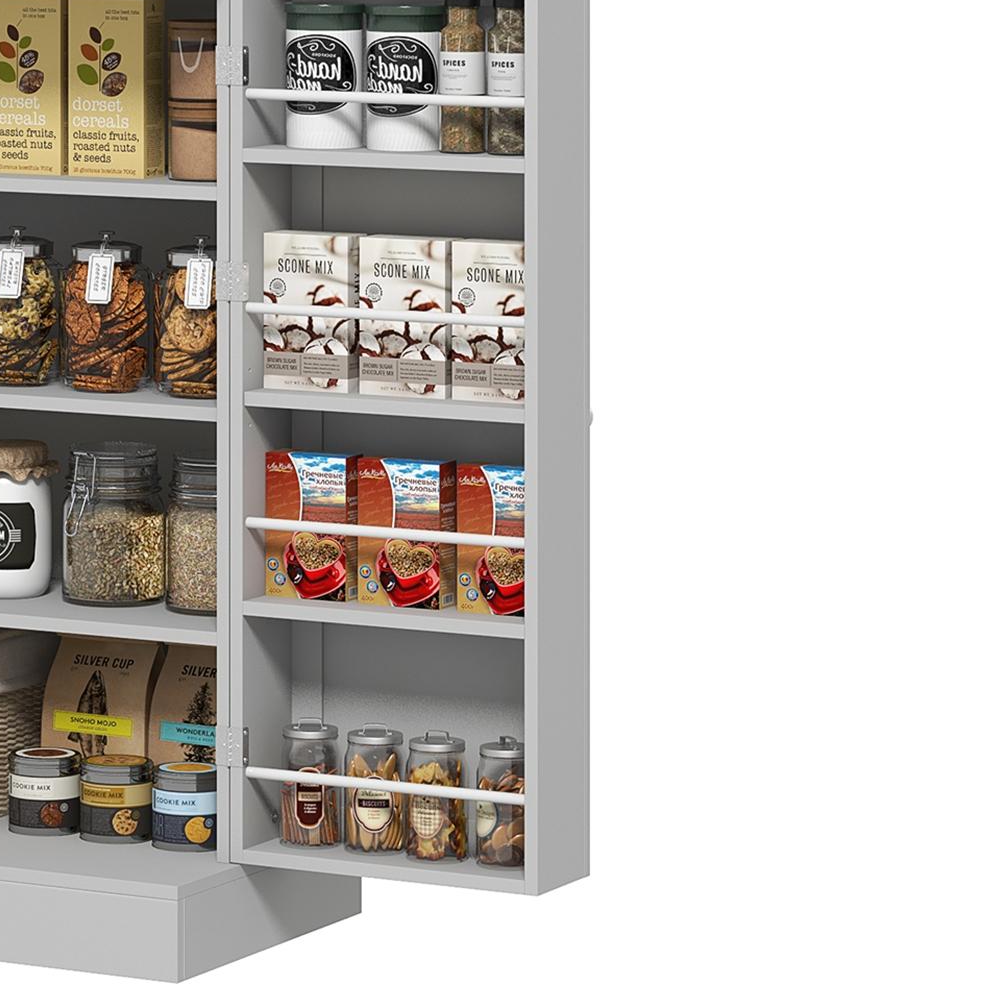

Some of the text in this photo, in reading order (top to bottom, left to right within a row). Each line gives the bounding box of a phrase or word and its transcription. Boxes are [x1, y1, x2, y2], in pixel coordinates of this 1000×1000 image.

[442, 59, 466, 67] SPICES
[491, 60, 515, 68] SPICES
[72, 97, 123, 113] dorset
[72, 114, 129, 129] cereals
[26, 128, 57, 140] fruits,
[72, 130, 140, 143] classic fruits,
[30, 141, 53, 150] nuts
[73, 142, 136, 153] roasted nuts
[1, 151, 29, 160] seeds
[72, 152, 112, 163] & seeds
[277, 258, 334, 275] SCONE MIX
[373, 262, 431, 280] SCONE MIX
[466, 267, 524, 284] SCONE MIX
[301, 469, 344, 479] Гречневые
[394, 475, 437, 486] Гречневые
[73, 654, 135, 670] SILVER CUP
[181, 664, 217, 679] SILVER
[70, 716, 118, 727] SNOHO MOJO
[175, 727, 216, 737] WONDERLA
[12, 782, 36, 791] COOKIE
[84, 789, 107, 798] COOKIE
[156, 796, 179, 805] COOKIE
